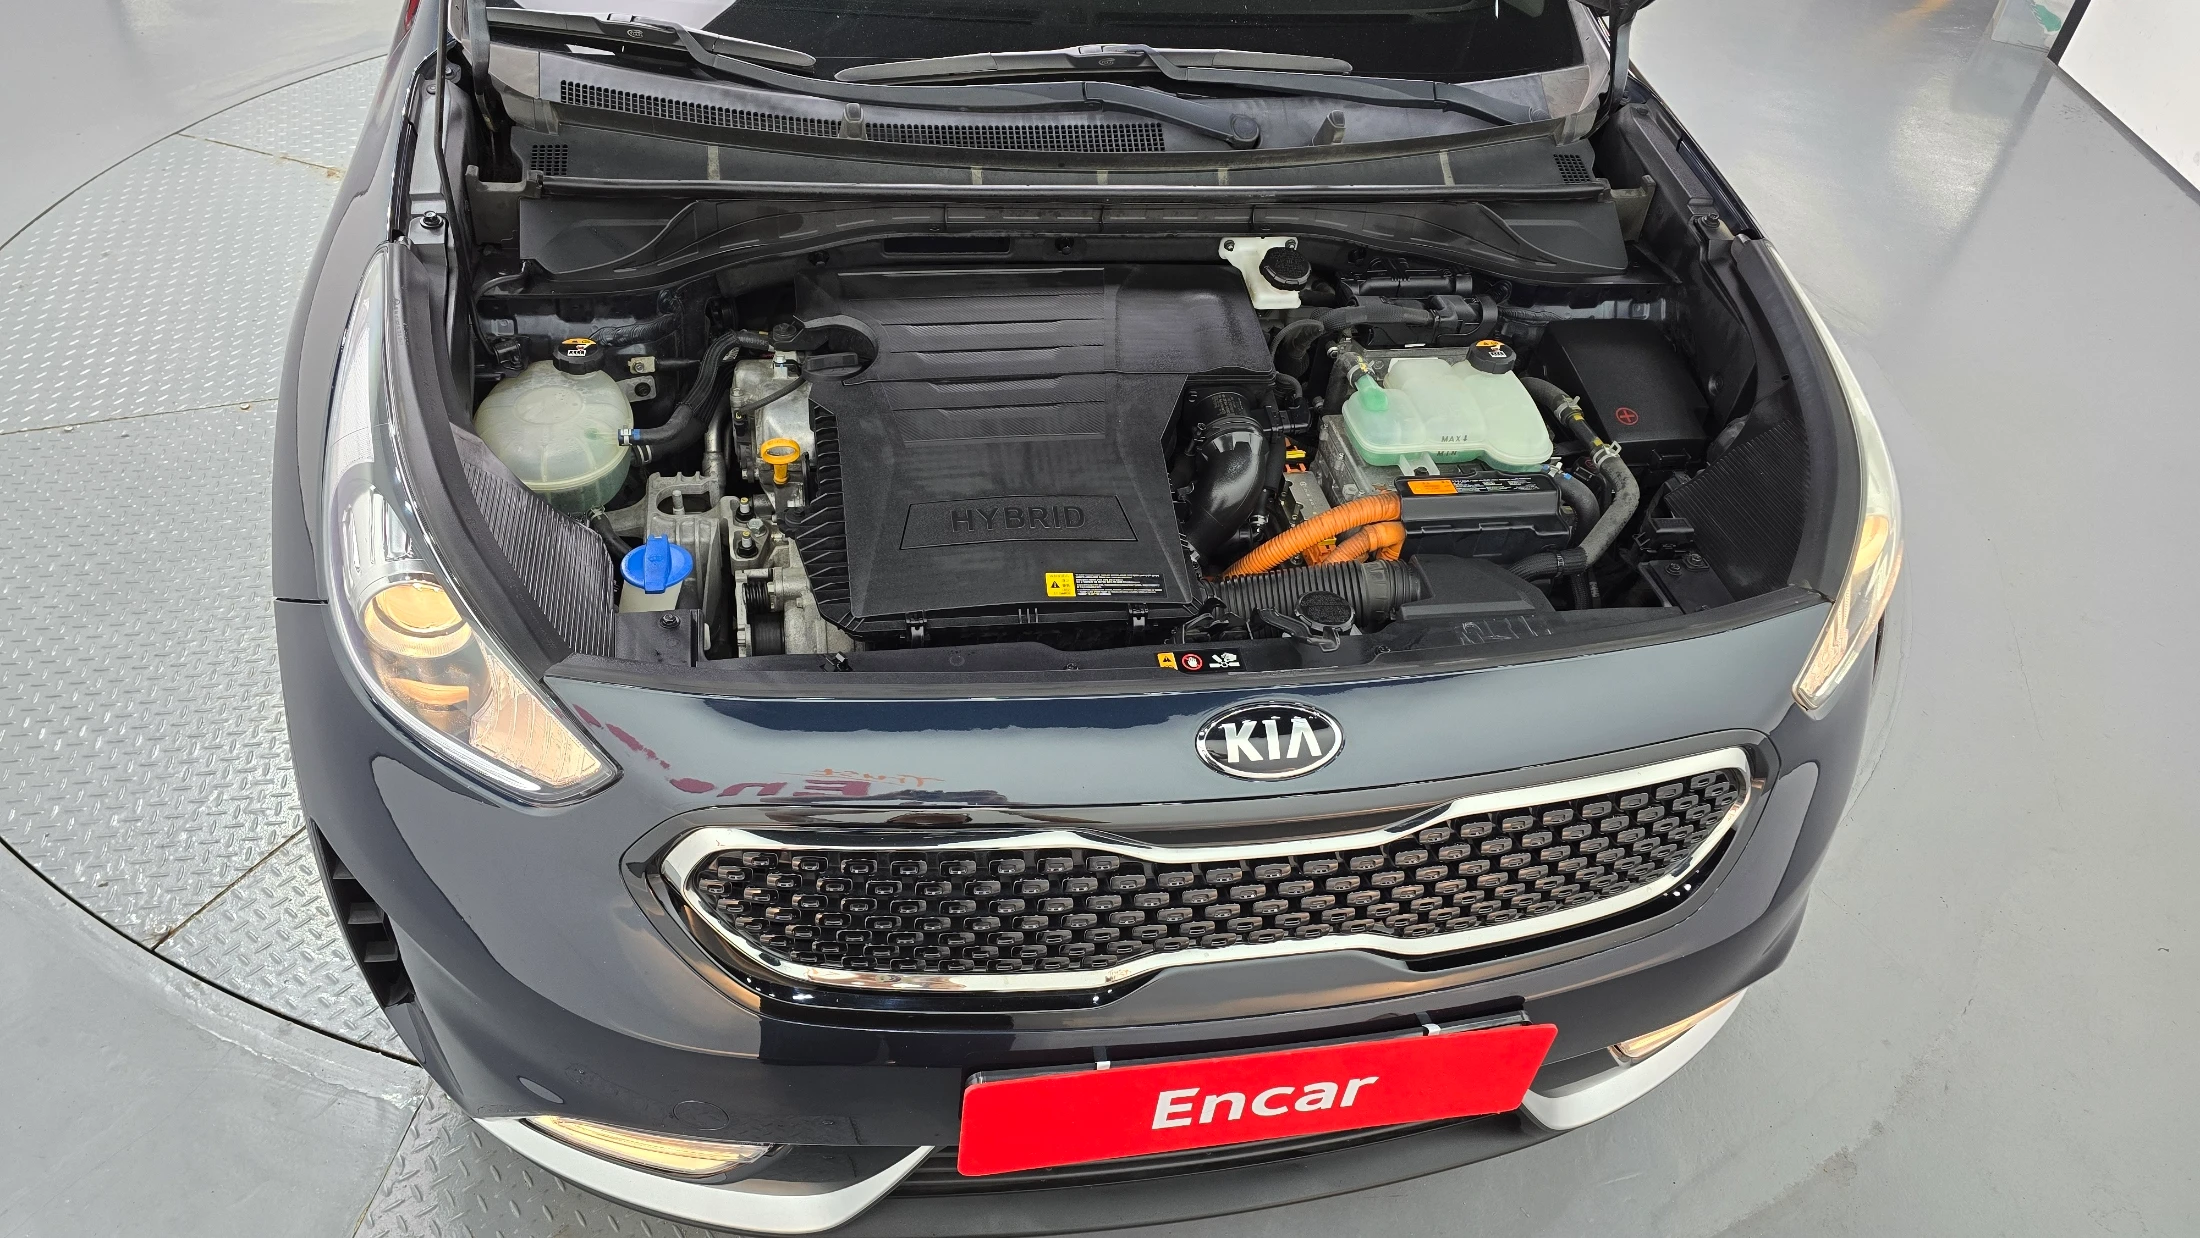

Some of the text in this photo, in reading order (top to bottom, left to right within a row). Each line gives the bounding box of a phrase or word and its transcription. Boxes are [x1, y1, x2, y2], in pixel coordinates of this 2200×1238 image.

[951, 505, 1086, 533] HYBRID
[1219, 715, 1323, 763] KIA
[1152, 1076, 1380, 1130] Encar
